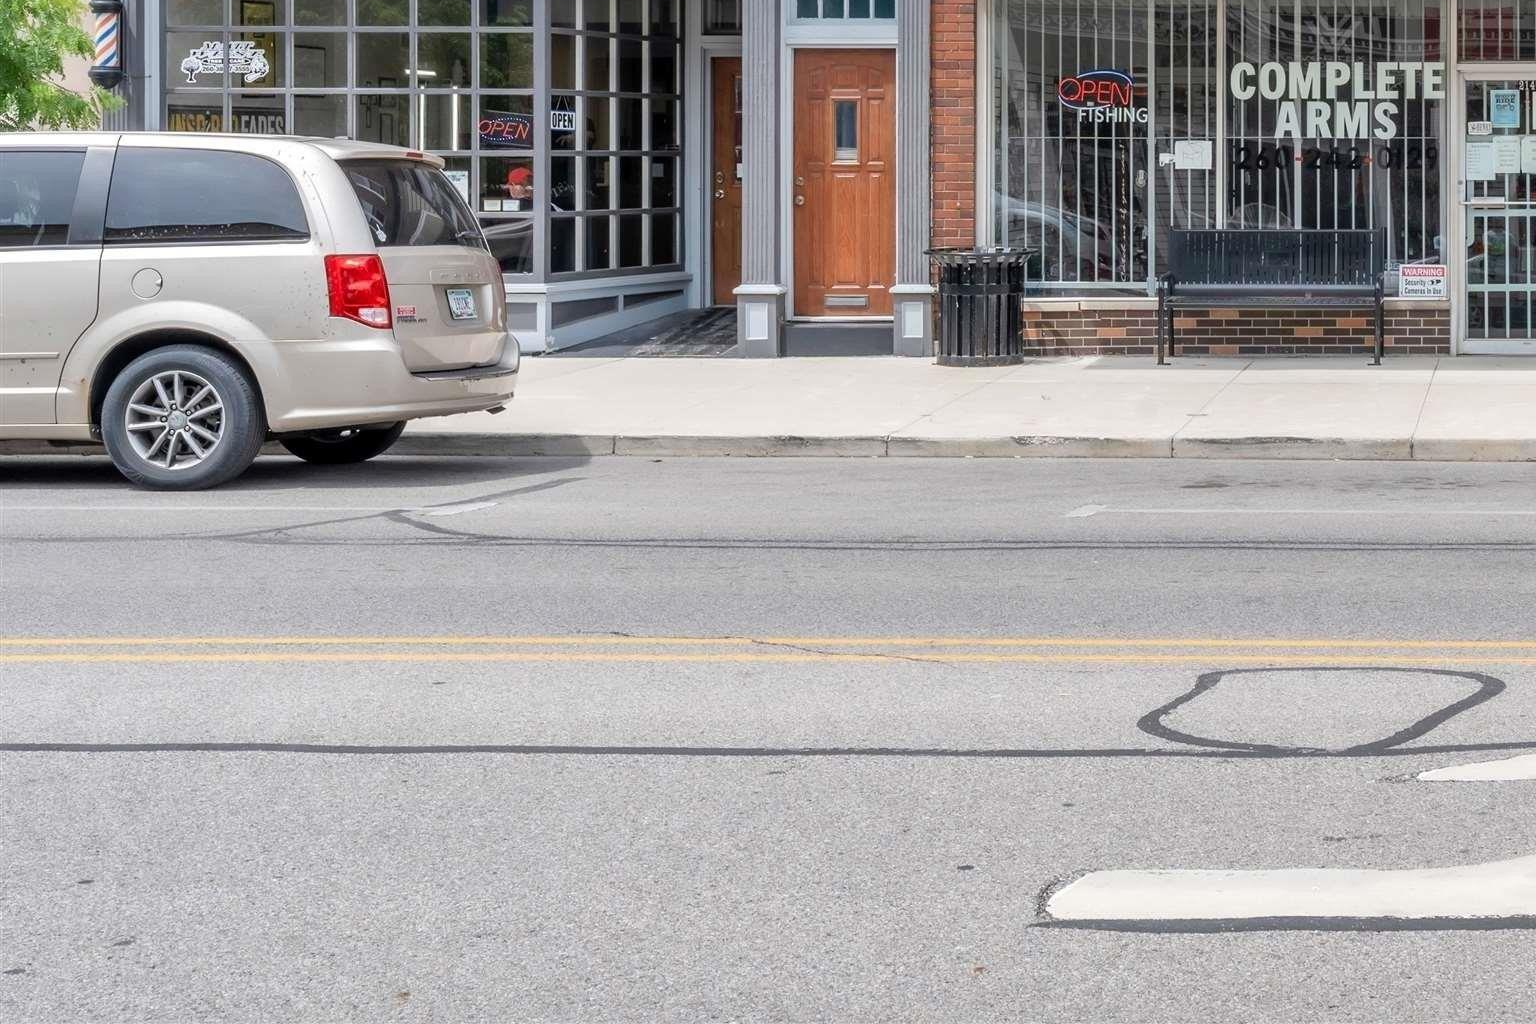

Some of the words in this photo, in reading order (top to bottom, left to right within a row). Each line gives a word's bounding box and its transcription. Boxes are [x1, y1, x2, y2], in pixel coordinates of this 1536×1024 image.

[1231, 61, 1445, 100] COMPLETE
[1519, 80, 1536, 90] 214
[1060, 78, 1130, 106] OPEN
[552, 113, 574, 128] OPEN
[1079, 108, 1148, 123] FISHING
[1274, 101, 1399, 140] ARMS
[478, 120, 529, 140] OPEN
[1404, 267, 1443, 276] WARNING
[1405, 287, 1425, 295] Cameras
